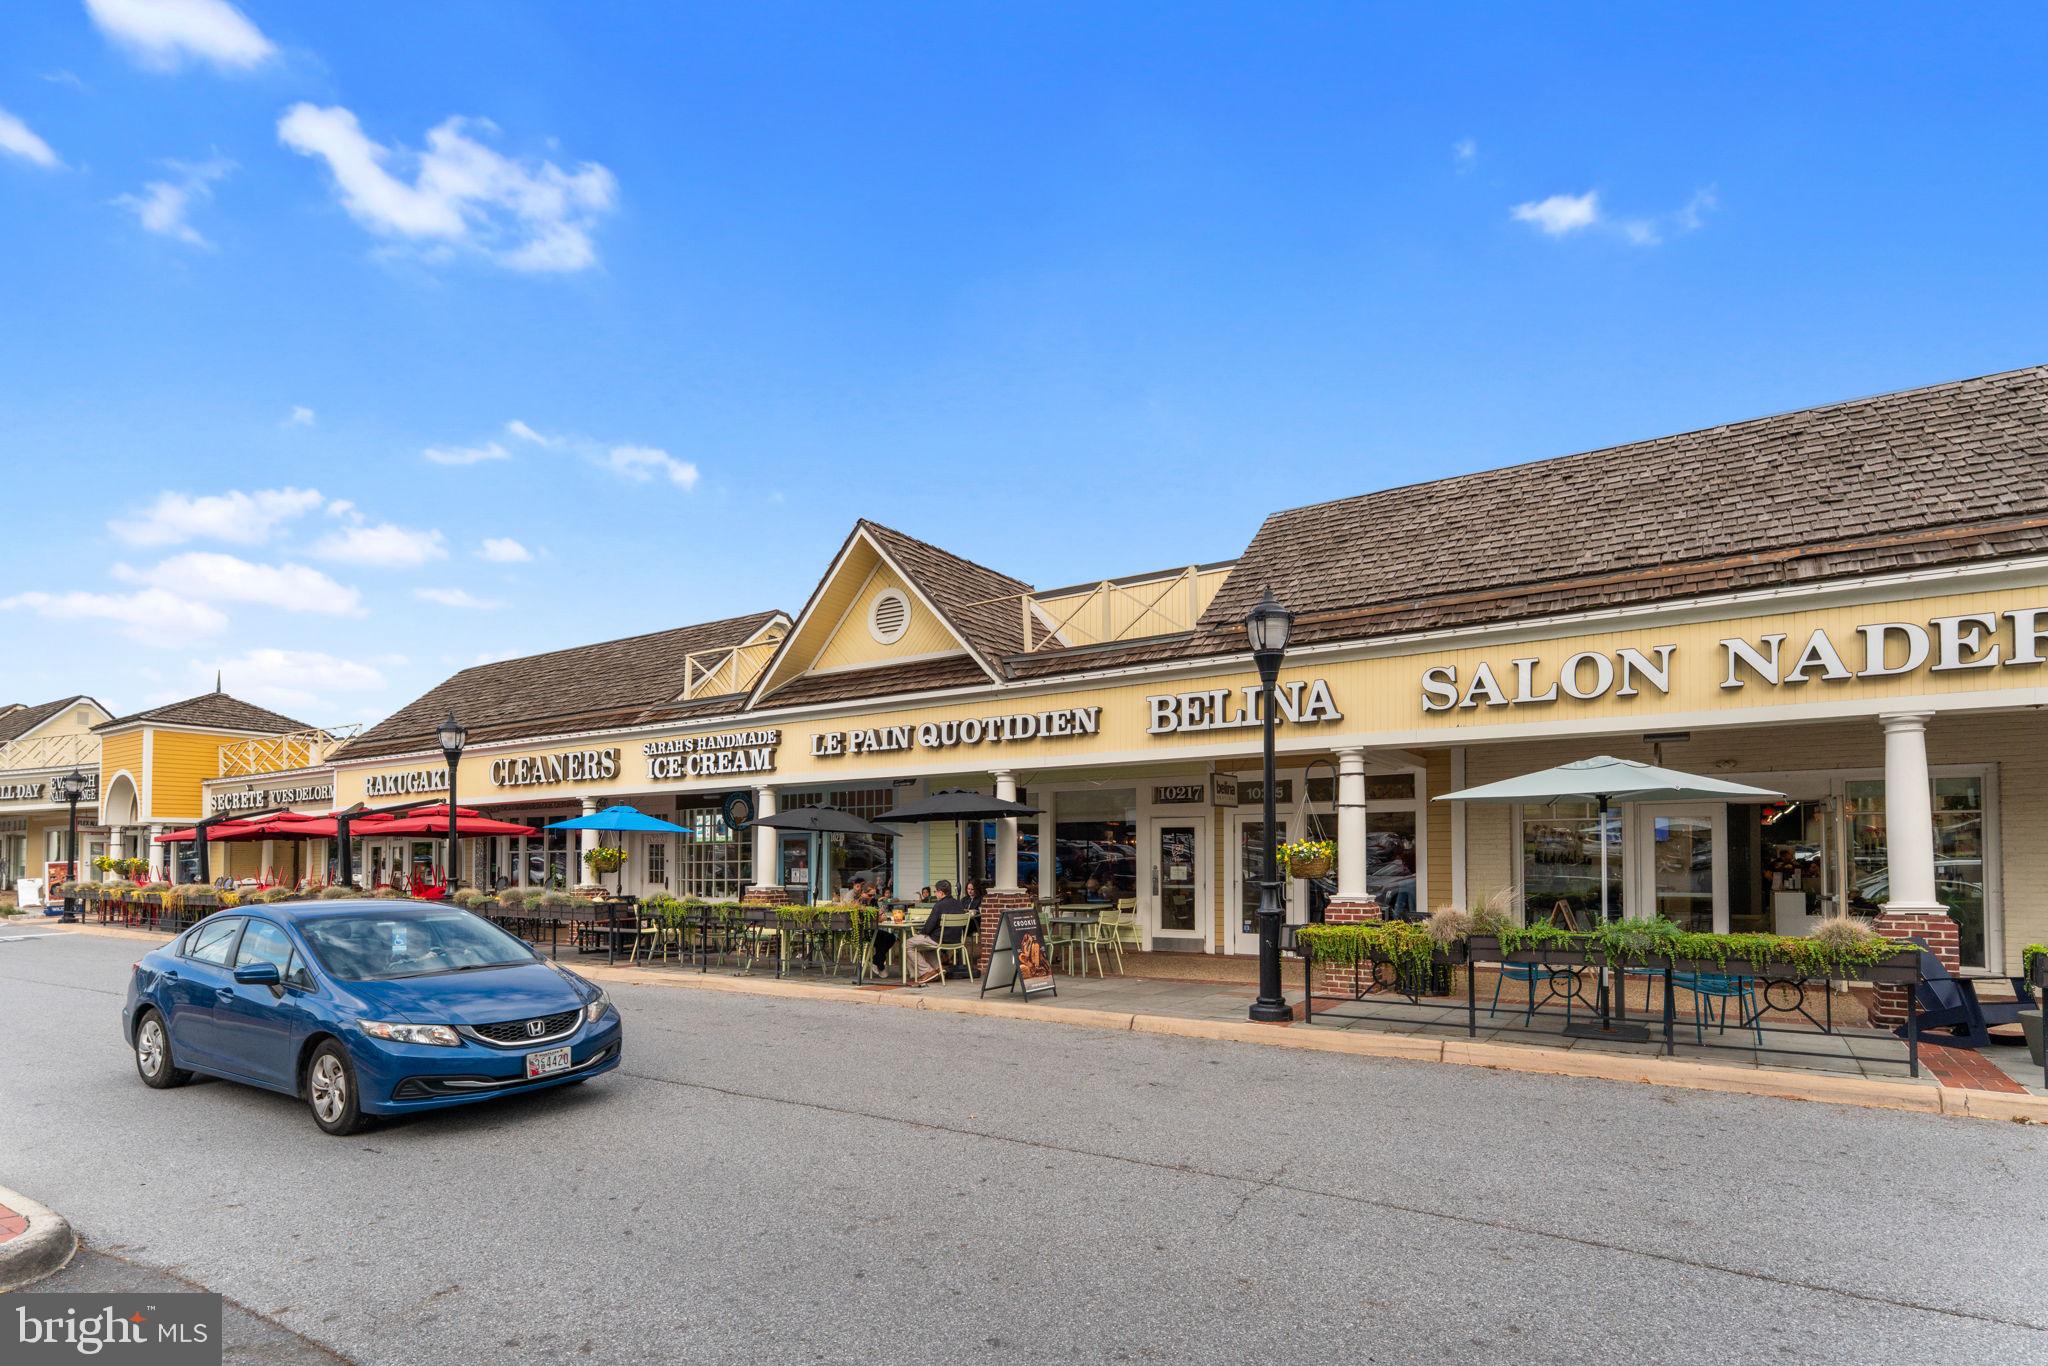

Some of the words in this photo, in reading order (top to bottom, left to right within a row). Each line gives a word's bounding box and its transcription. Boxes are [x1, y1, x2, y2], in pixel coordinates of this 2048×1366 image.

[1422, 643, 1676, 711] SALON
[1146, 679, 1342, 734] BELINA
[697, 730, 778, 751] HANDMADE
[809, 732, 842, 757] LE
[849, 724, 912, 753] PAIN
[916, 706, 1100, 749] QUOTIDIEN
[489, 747, 617, 787] CLEANERS
[646, 755, 684, 779] ICE
[687, 748, 773, 776] CREAM
[16, 783, 41, 798] DAY
[364, 768, 450, 796] RAKUGAKI
[1159, 786, 1202, 800] 10217
[1247, 786, 1284, 799] 105
[269, 789, 295, 804] YVES
